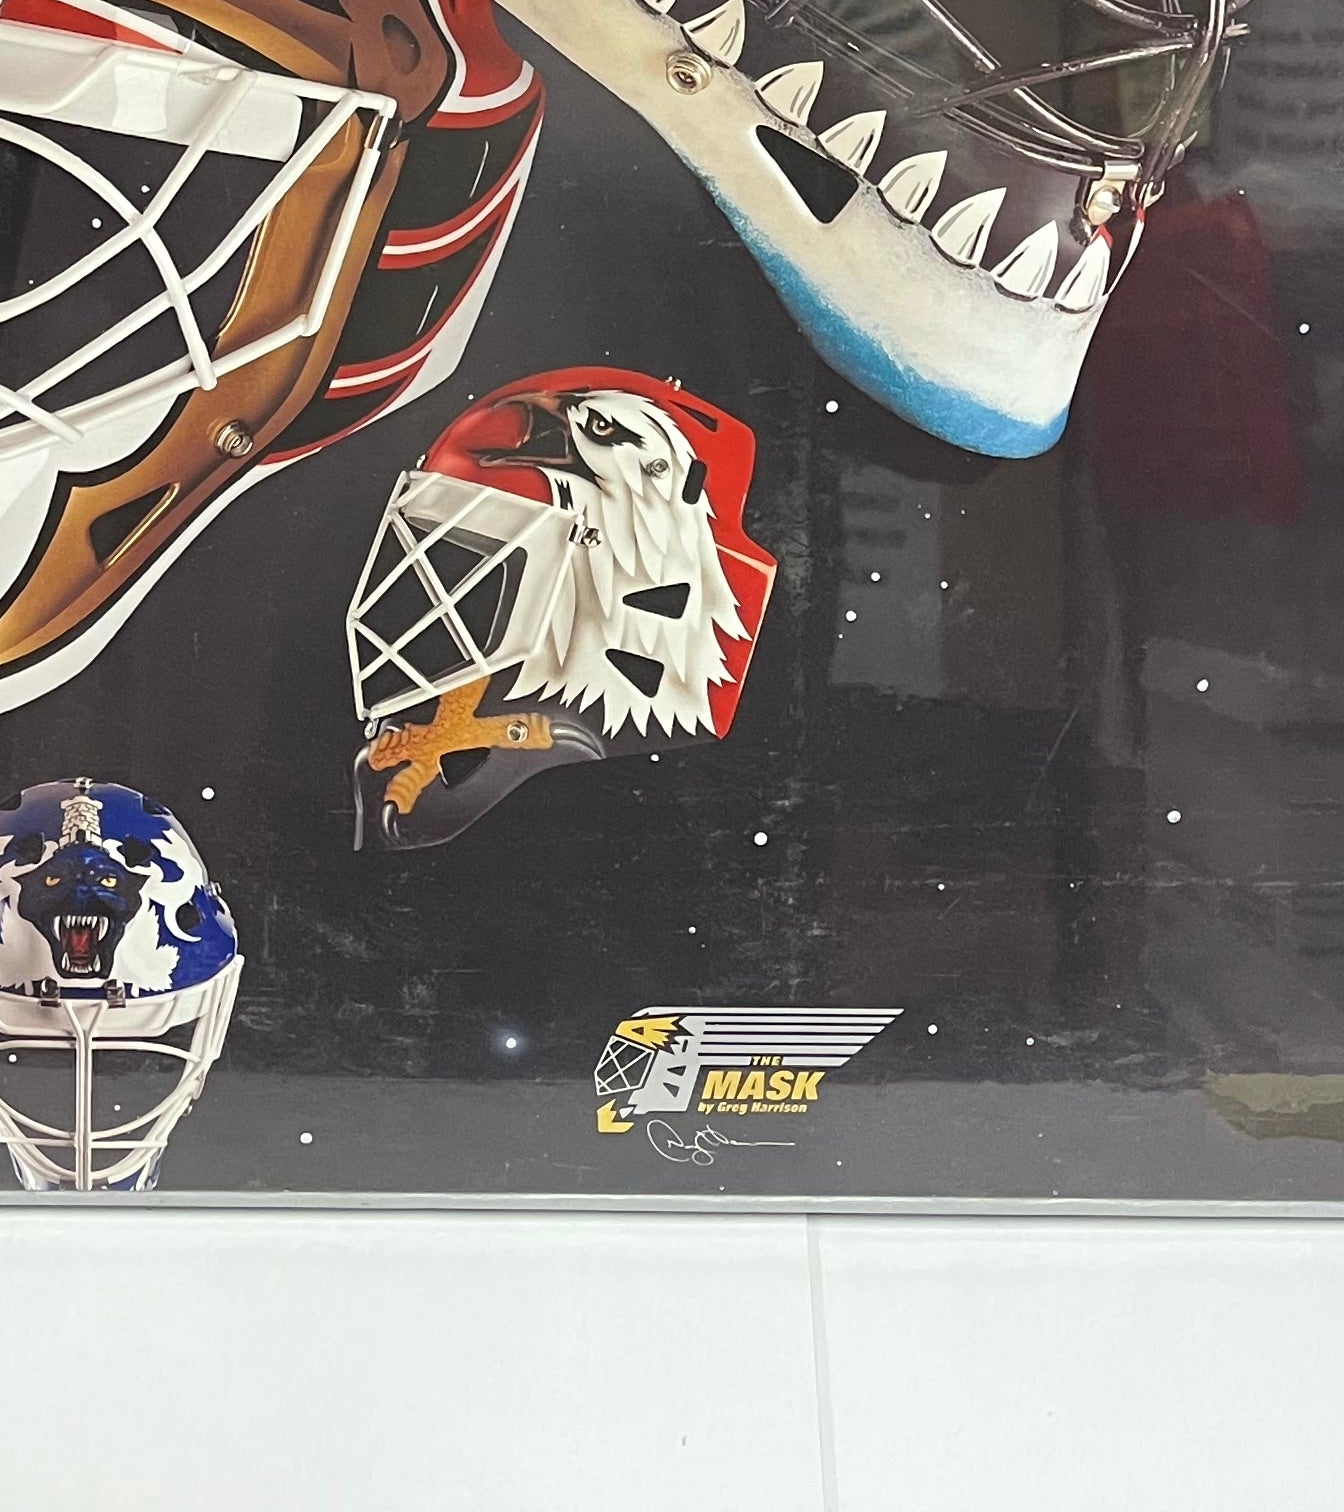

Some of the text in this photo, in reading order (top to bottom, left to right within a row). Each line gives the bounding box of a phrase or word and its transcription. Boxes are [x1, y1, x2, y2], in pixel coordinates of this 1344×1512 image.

[752, 1055, 783, 1066] THE
[701, 1070, 826, 1101] MASK
[697, 1101, 808, 1116] by Greg Harrison
